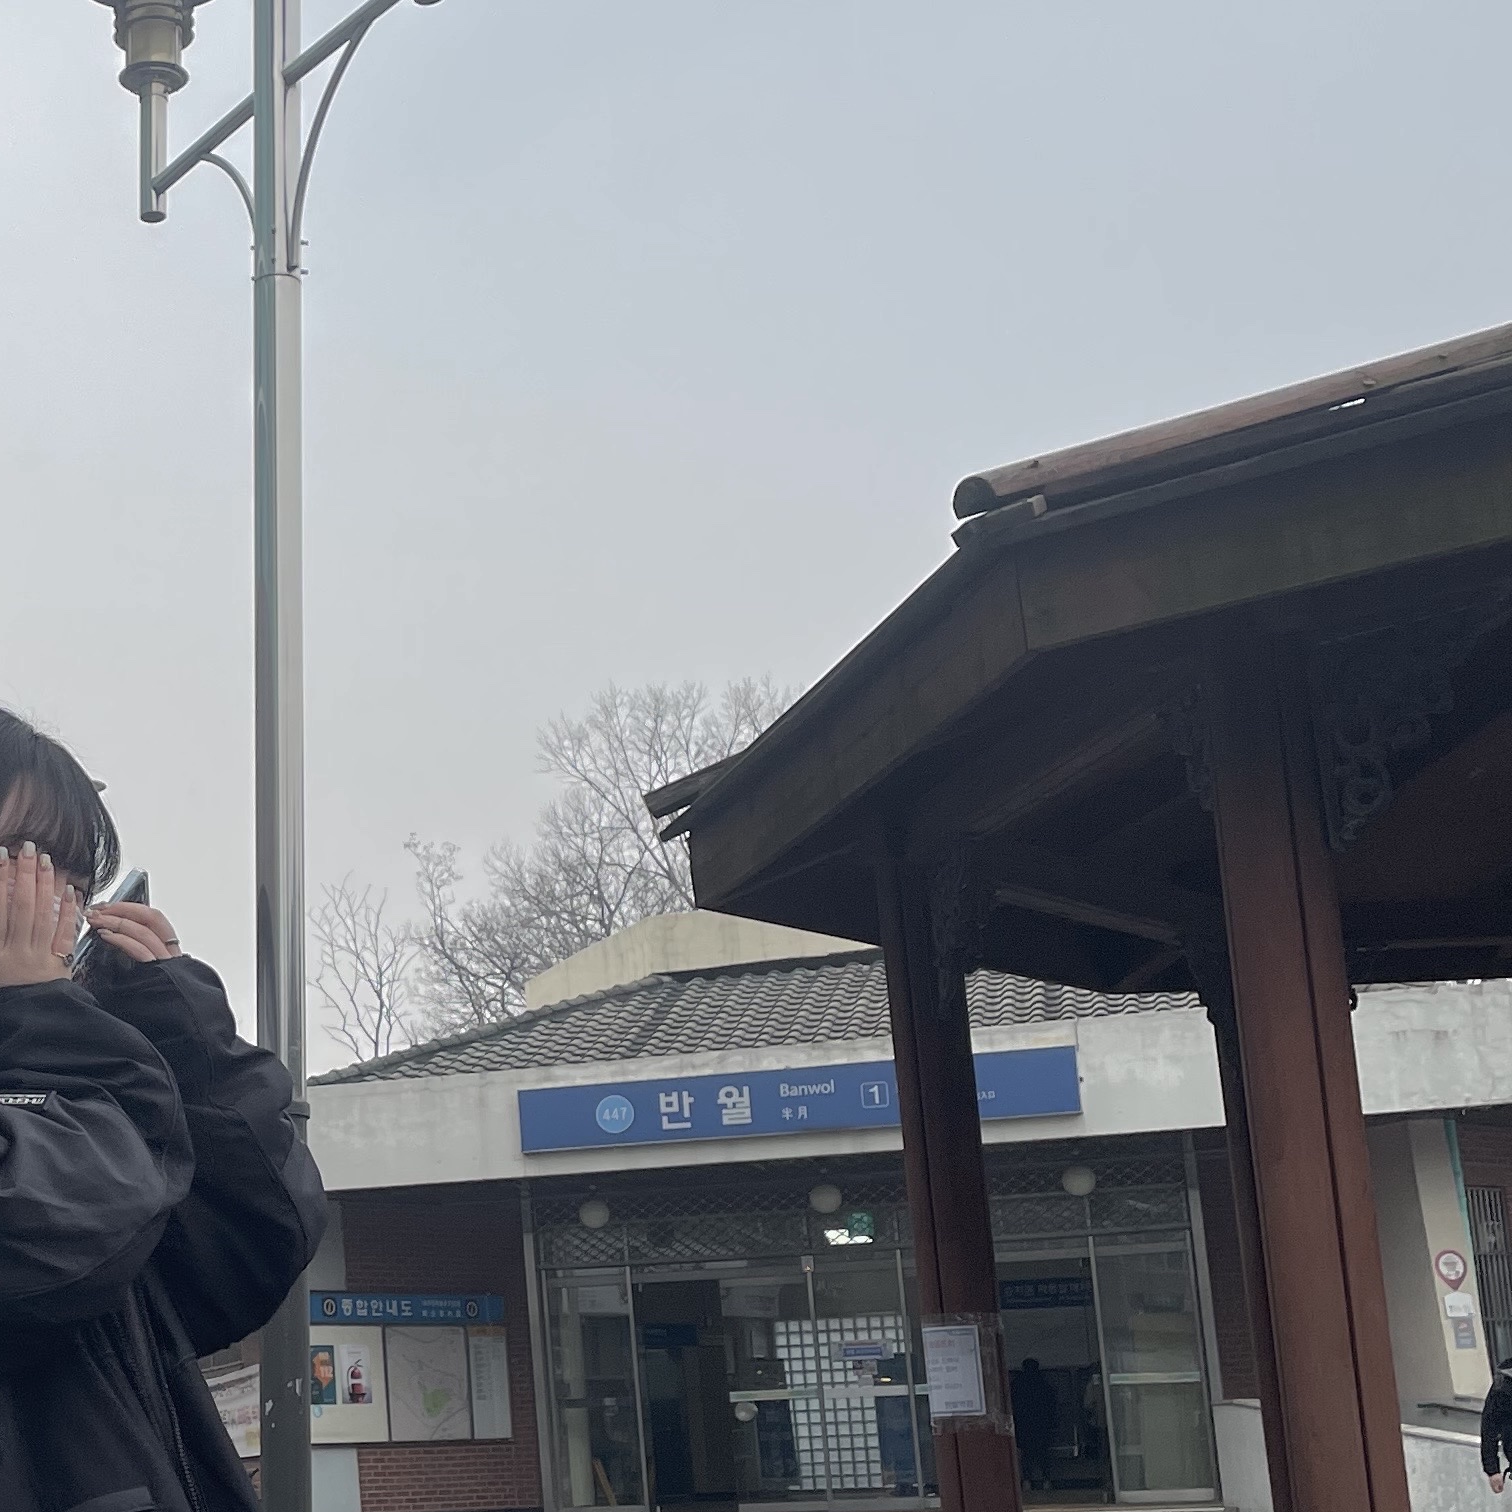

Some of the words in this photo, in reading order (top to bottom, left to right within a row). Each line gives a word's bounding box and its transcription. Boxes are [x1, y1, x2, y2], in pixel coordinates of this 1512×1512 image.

[779, 1079, 835, 1098] Banwol
[602, 1107, 627, 1121] 447
[341, 1298, 414, 1317] 종합안내도
